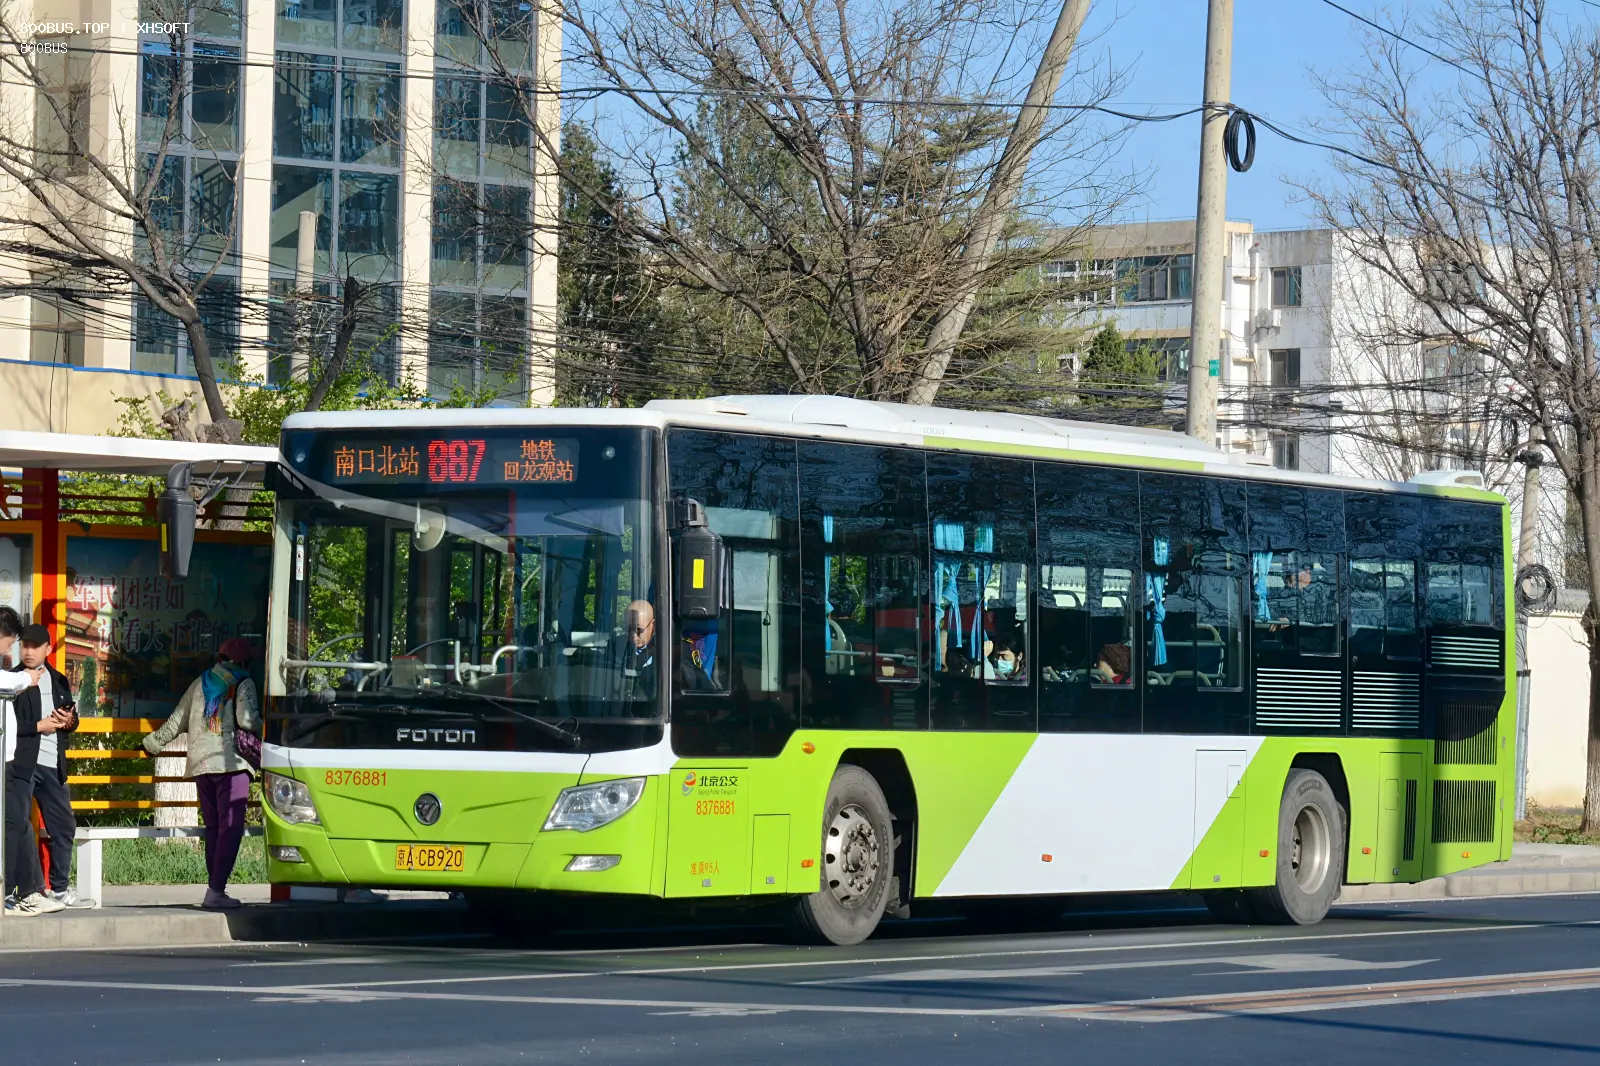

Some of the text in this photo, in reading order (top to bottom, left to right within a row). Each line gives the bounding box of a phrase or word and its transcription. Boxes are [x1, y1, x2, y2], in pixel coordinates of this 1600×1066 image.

[520, 440, 556, 461] 地铁
[334, 445, 419, 477] 南口北站
[428, 440, 485, 482] 887
[504, 460, 574, 482] 回龙观站
[396, 727, 476, 744] FOTON
[325, 770, 387, 787] 8376881
[699, 775, 738, 787] 北京公交
[696, 800, 735, 815] 8376881
